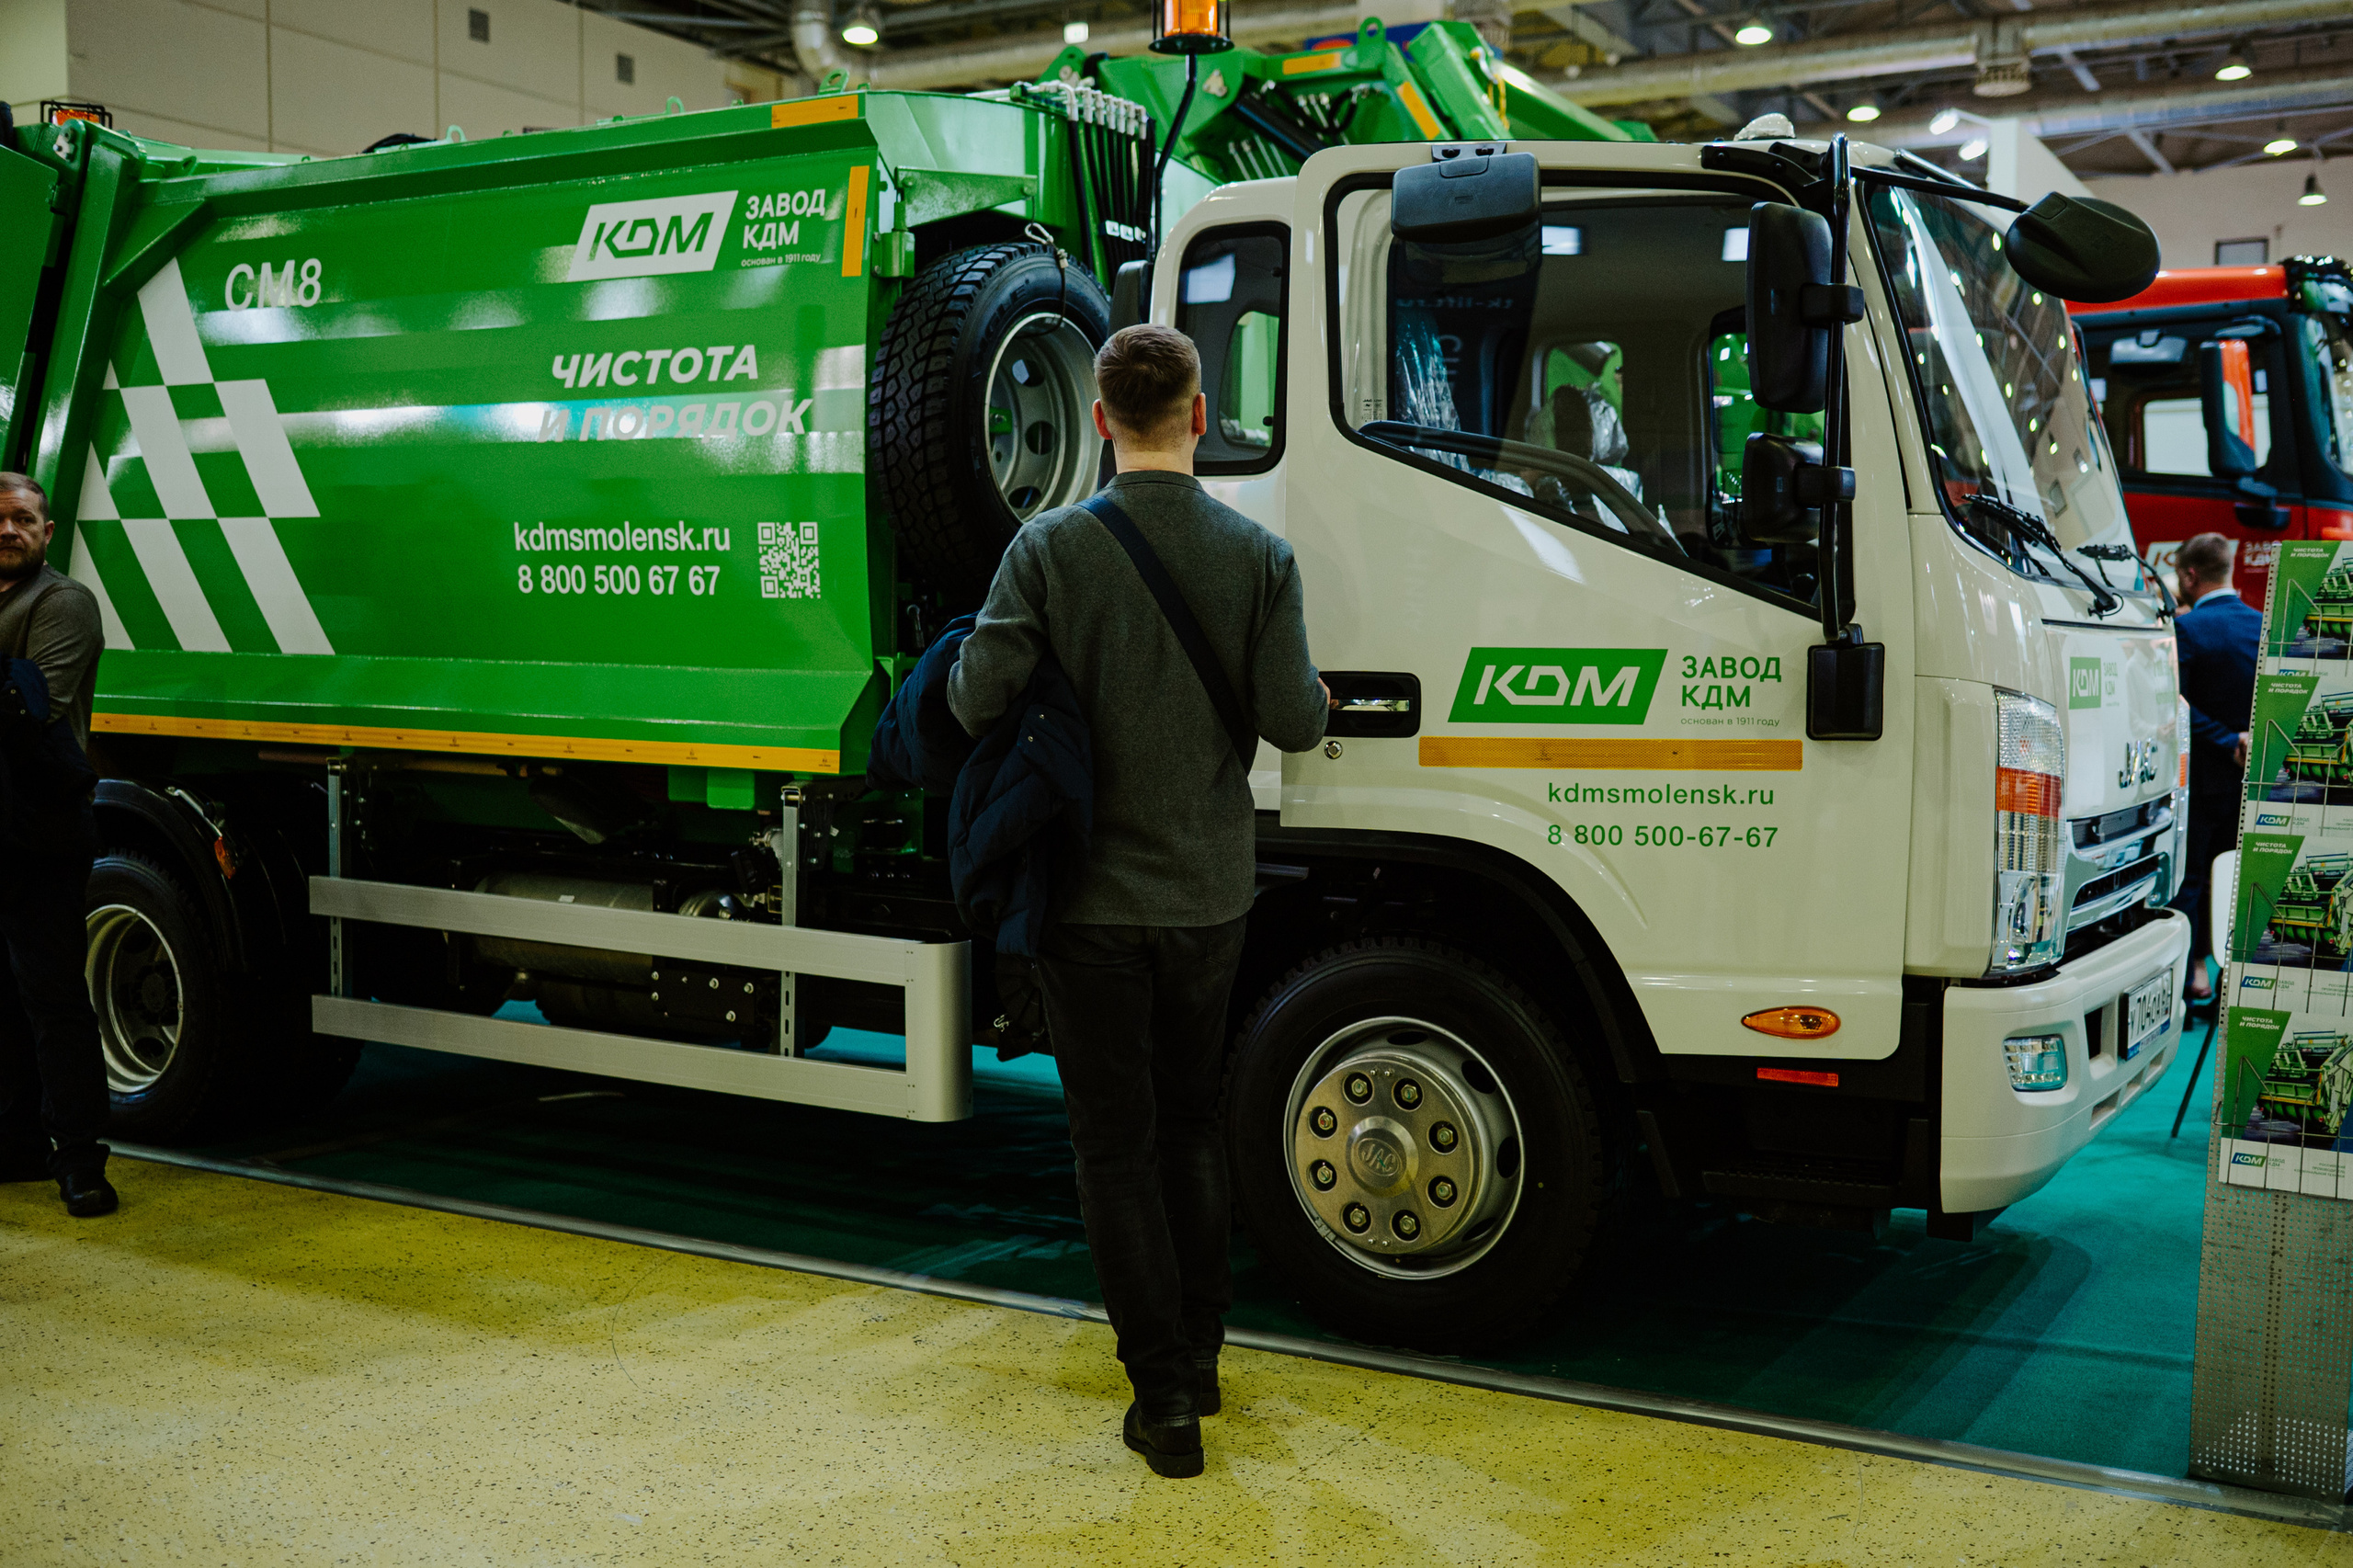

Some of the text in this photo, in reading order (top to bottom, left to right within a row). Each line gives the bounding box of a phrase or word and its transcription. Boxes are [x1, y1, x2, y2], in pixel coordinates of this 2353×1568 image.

[745, 188, 825, 220] ЗАВОД
[586, 211, 715, 262] KDM
[743, 220, 800, 251] КДМ
[741, 257, 776, 267] основан
[785, 253, 801, 263] 1911
[801, 253, 821, 263] году
[551, 345, 758, 389] ЧИСТОТА
[537, 398, 813, 445] И ПОРЯДОК
[514, 521, 731, 552] kdmsmolensk.ru
[517, 564, 721, 597] 8 800 500 67 67
[1681, 655, 1781, 682] ЗАВОД
[1473, 665, 1641, 706] KDM
[1682, 685, 1750, 710] КДМ
[2073, 669, 2099, 698] KDM
[1736, 717, 1755, 725] 1911
[1756, 718, 1780, 727] году
[2118, 737, 2158, 789] JAC
[1548, 782, 1775, 805] kdmsmolensk.ru
[2259, 816, 2288, 824] KDM
[1547, 824, 1779, 848] 8 800 500-67-67
[2245, 978, 2272, 987] KDM
[1361, 1143, 1395, 1173] JAC
[2235, 1154, 2263, 1165] KDM
